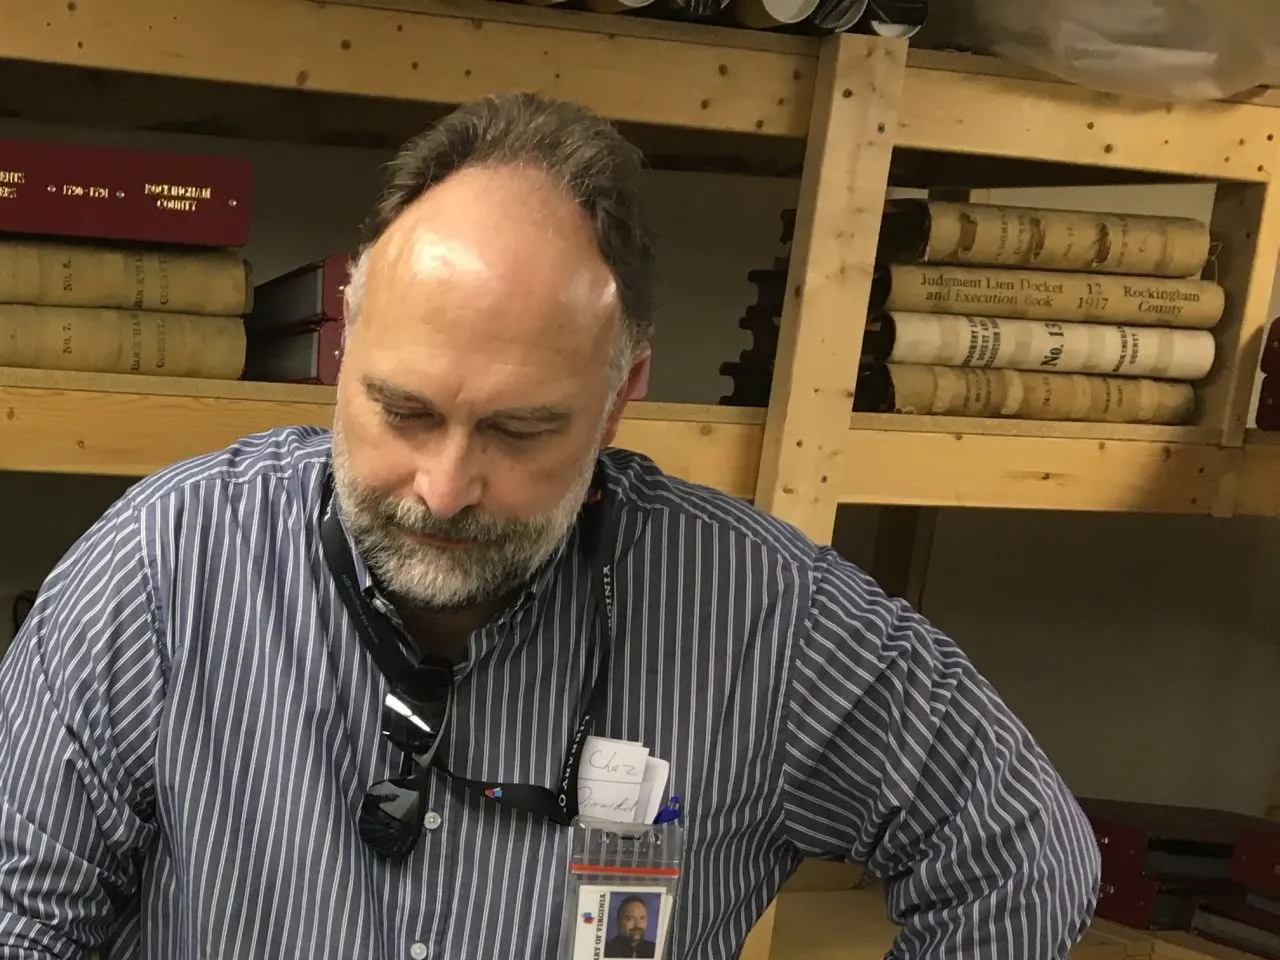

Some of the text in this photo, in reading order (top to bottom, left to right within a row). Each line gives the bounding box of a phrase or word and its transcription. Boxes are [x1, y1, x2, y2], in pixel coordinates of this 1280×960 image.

[145, 184, 211, 200] ROCKINGHAM
[157, 199, 197, 212] COUNTY
[920, 273, 1064, 294] Judgment Lien Docket
[925, 290, 1053, 308] and Execution Book
[1123, 285, 1200, 302] Rockingham
[1137, 300, 1184, 315] County
[1040, 323, 1064, 367] No. 13
[597, 893, 607, 933] VIRGINIA
[595, 934, 602, 946] OF
